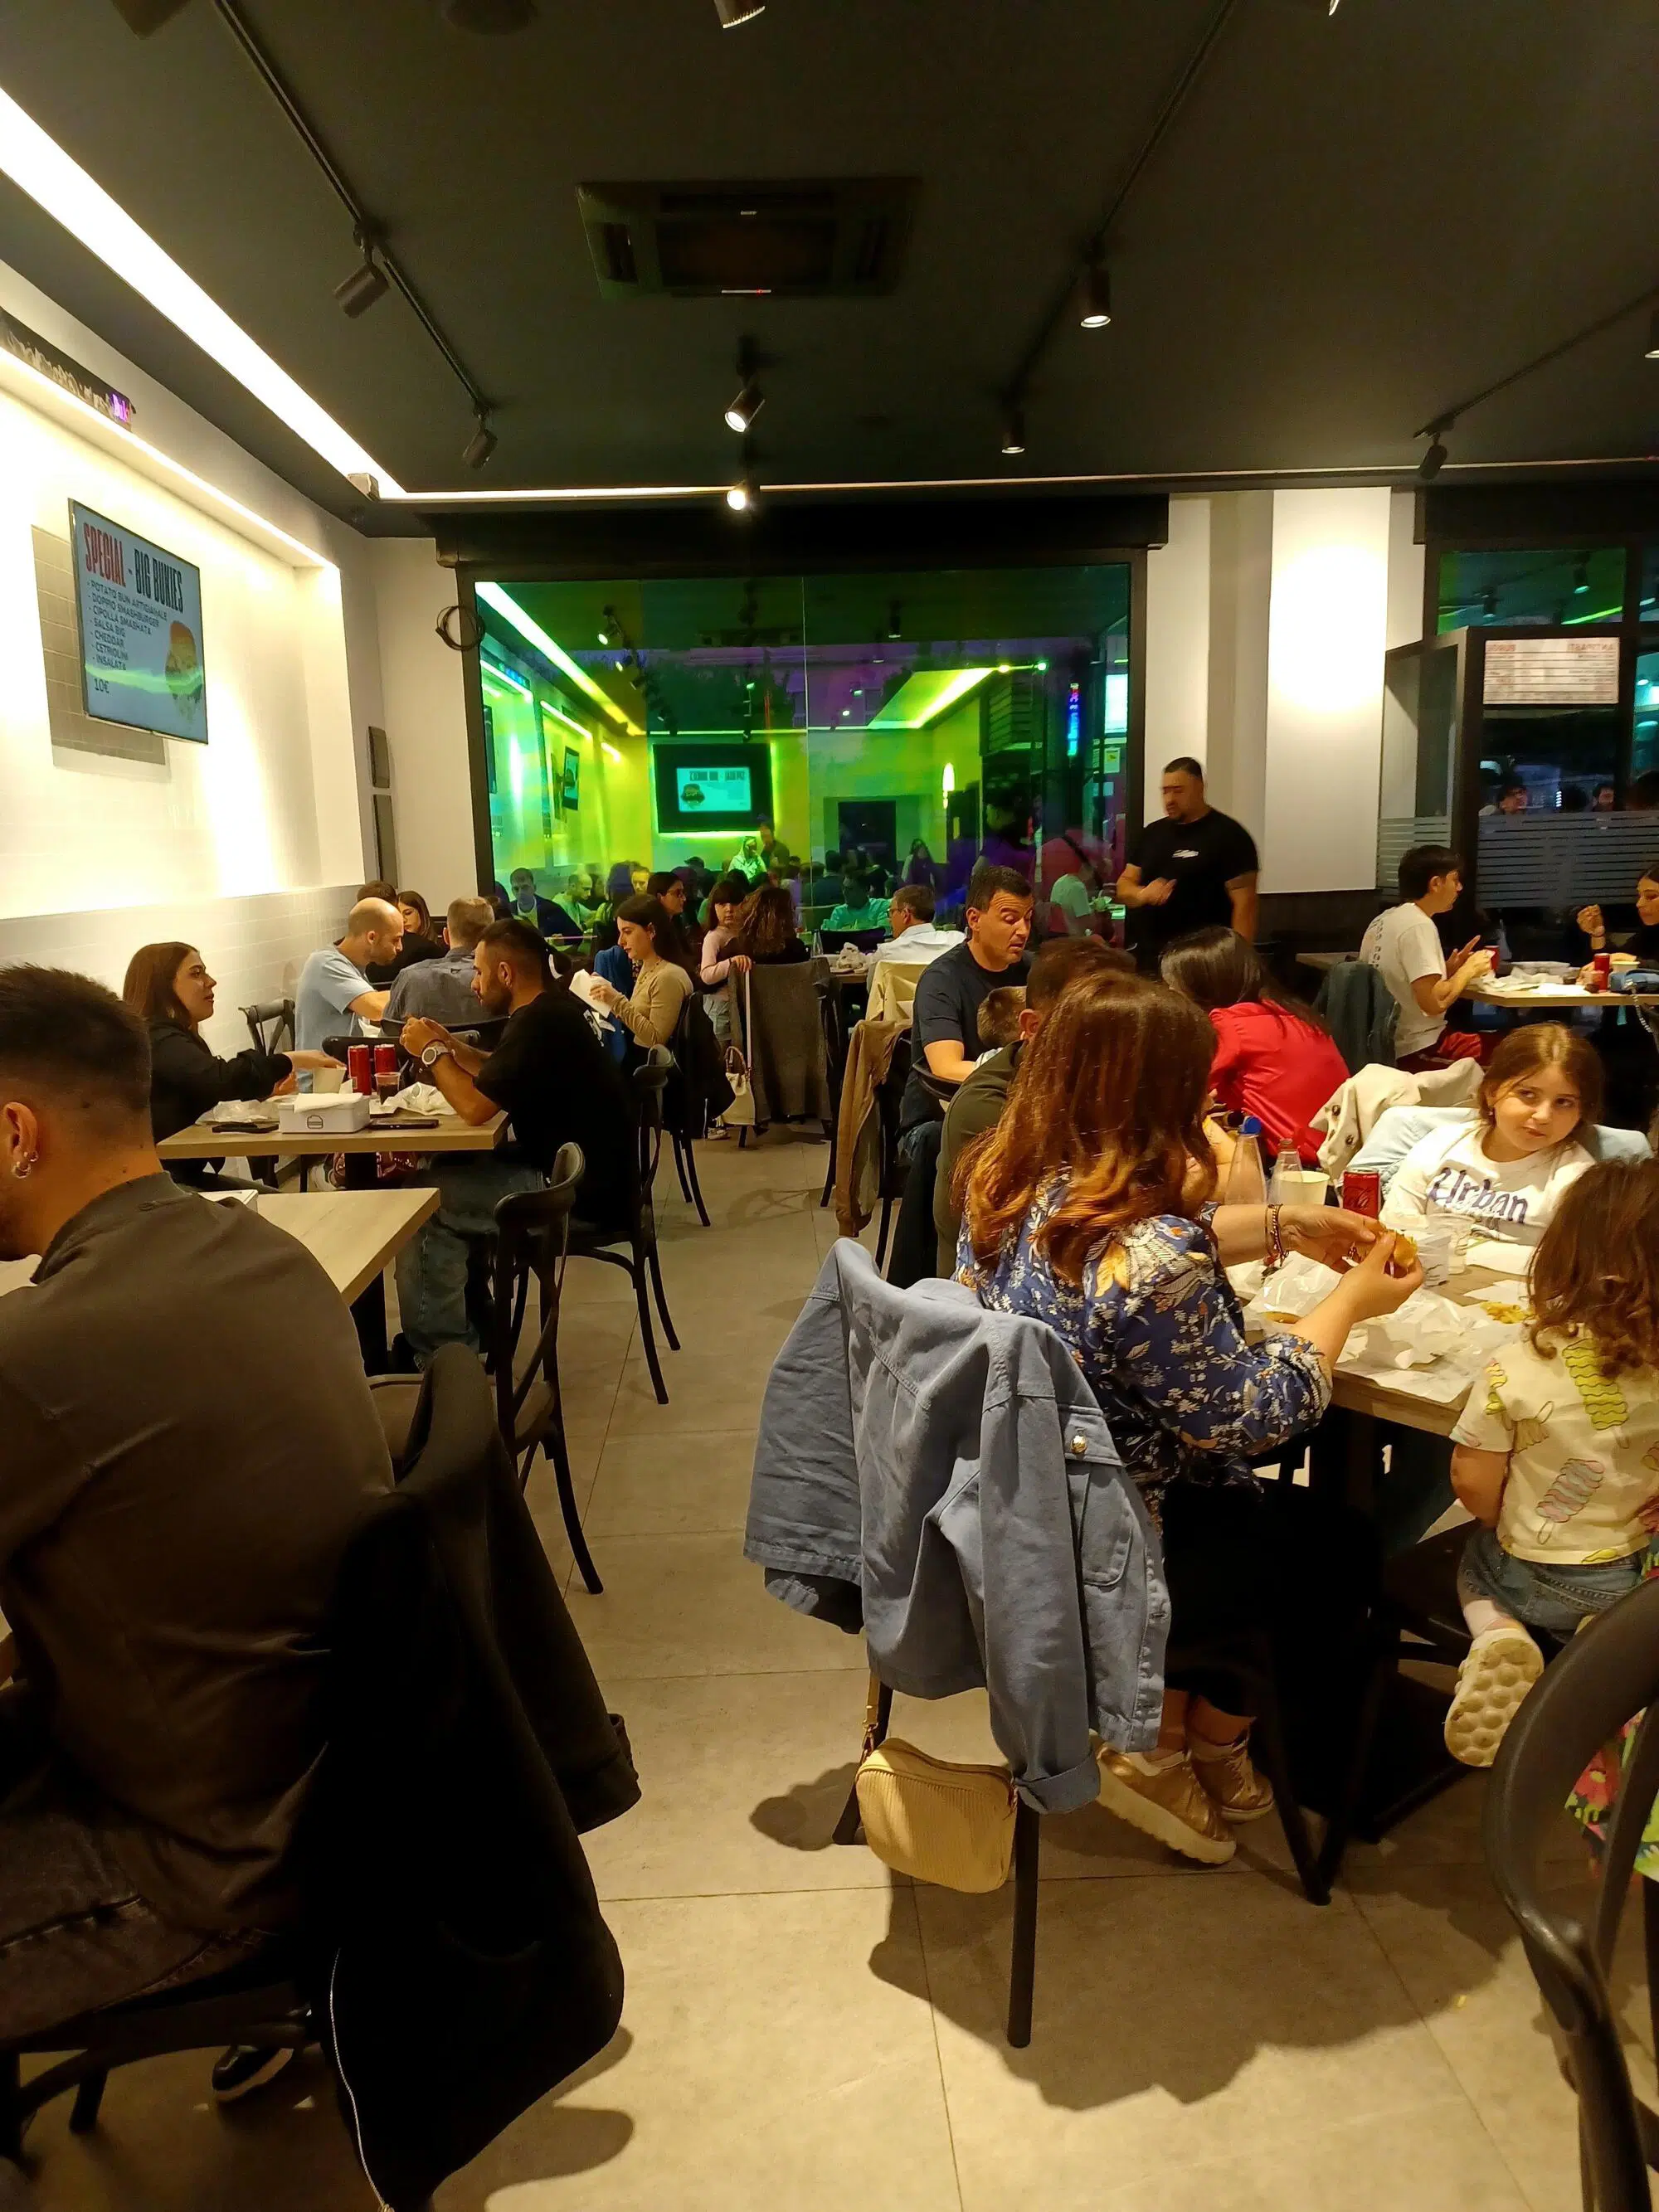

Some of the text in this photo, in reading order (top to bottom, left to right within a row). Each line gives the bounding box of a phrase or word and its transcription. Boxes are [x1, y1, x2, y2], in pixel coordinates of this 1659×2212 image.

[134, 548, 151, 599] BIG
[153, 557, 183, 614] BUKIES
[91, 580, 117, 598] POTATO
[117, 591, 130, 605] BUN
[93, 605, 119, 623] CIPOLLA
[94, 618, 125, 638] SALSA BIG
[95, 630, 124, 648] CHEDDAR
[96, 654, 126, 670] INSALATA
[94, 678, 109, 694] 10€
[1429, 1167, 1528, 1224] Urban
